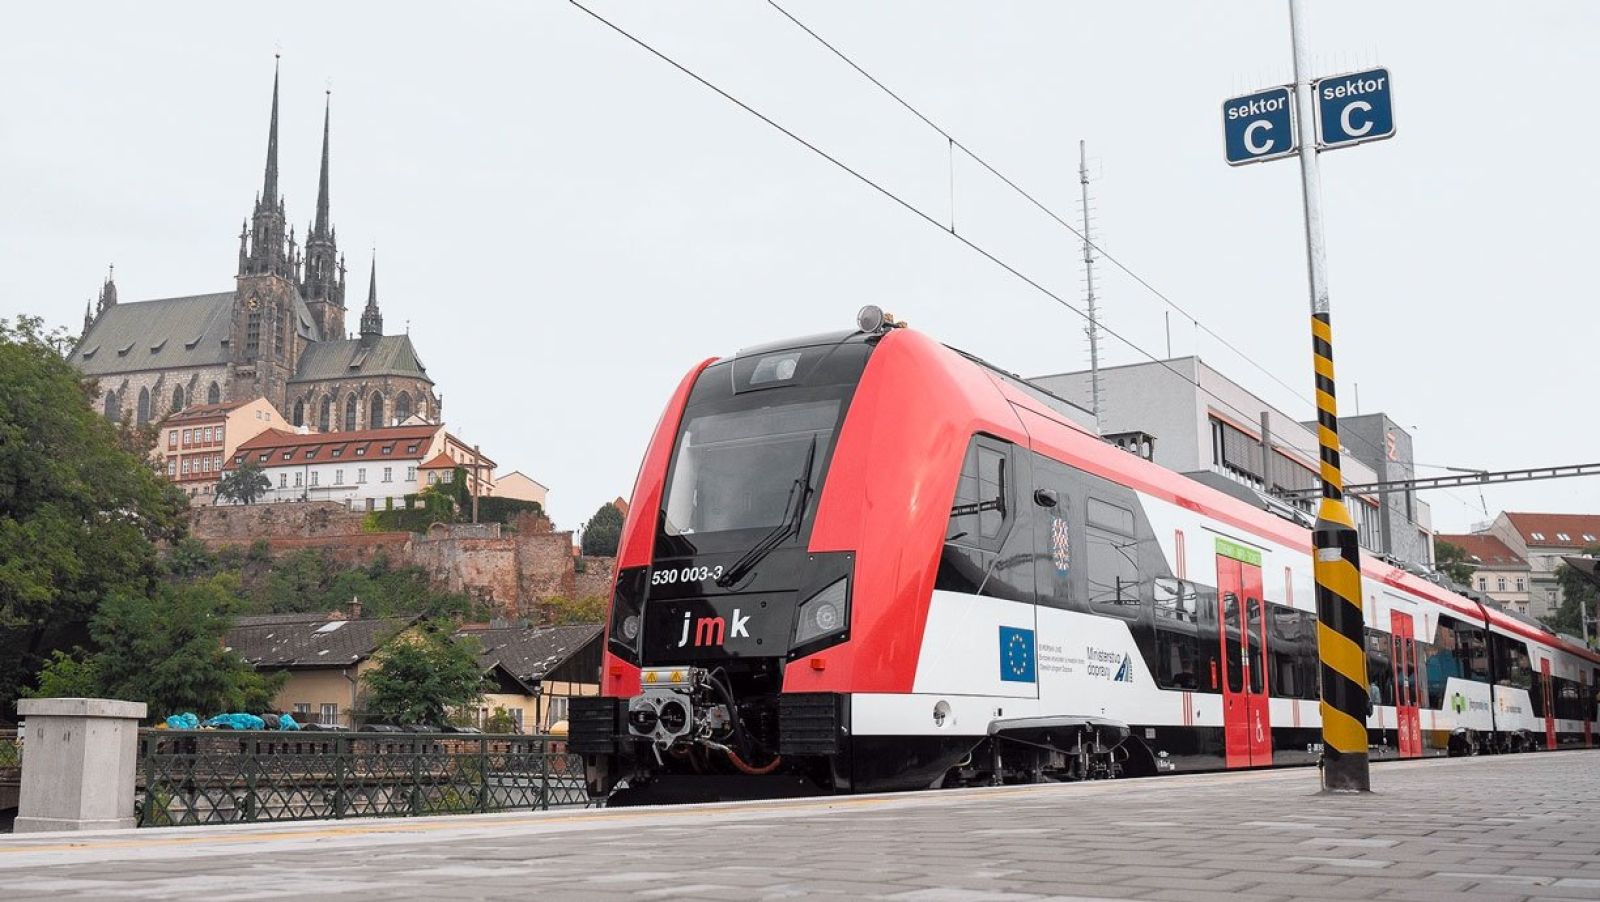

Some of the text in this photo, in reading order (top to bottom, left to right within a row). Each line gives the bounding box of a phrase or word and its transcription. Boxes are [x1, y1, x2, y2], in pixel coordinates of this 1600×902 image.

[1324, 77, 1384, 99] sektor
[1228, 97, 1285, 119] sektor
[1340, 101, 1373, 136] C
[1244, 120, 1274, 154] C
[652, 566, 723, 585] 530 003-3
[678, 608, 751, 647] jmk
